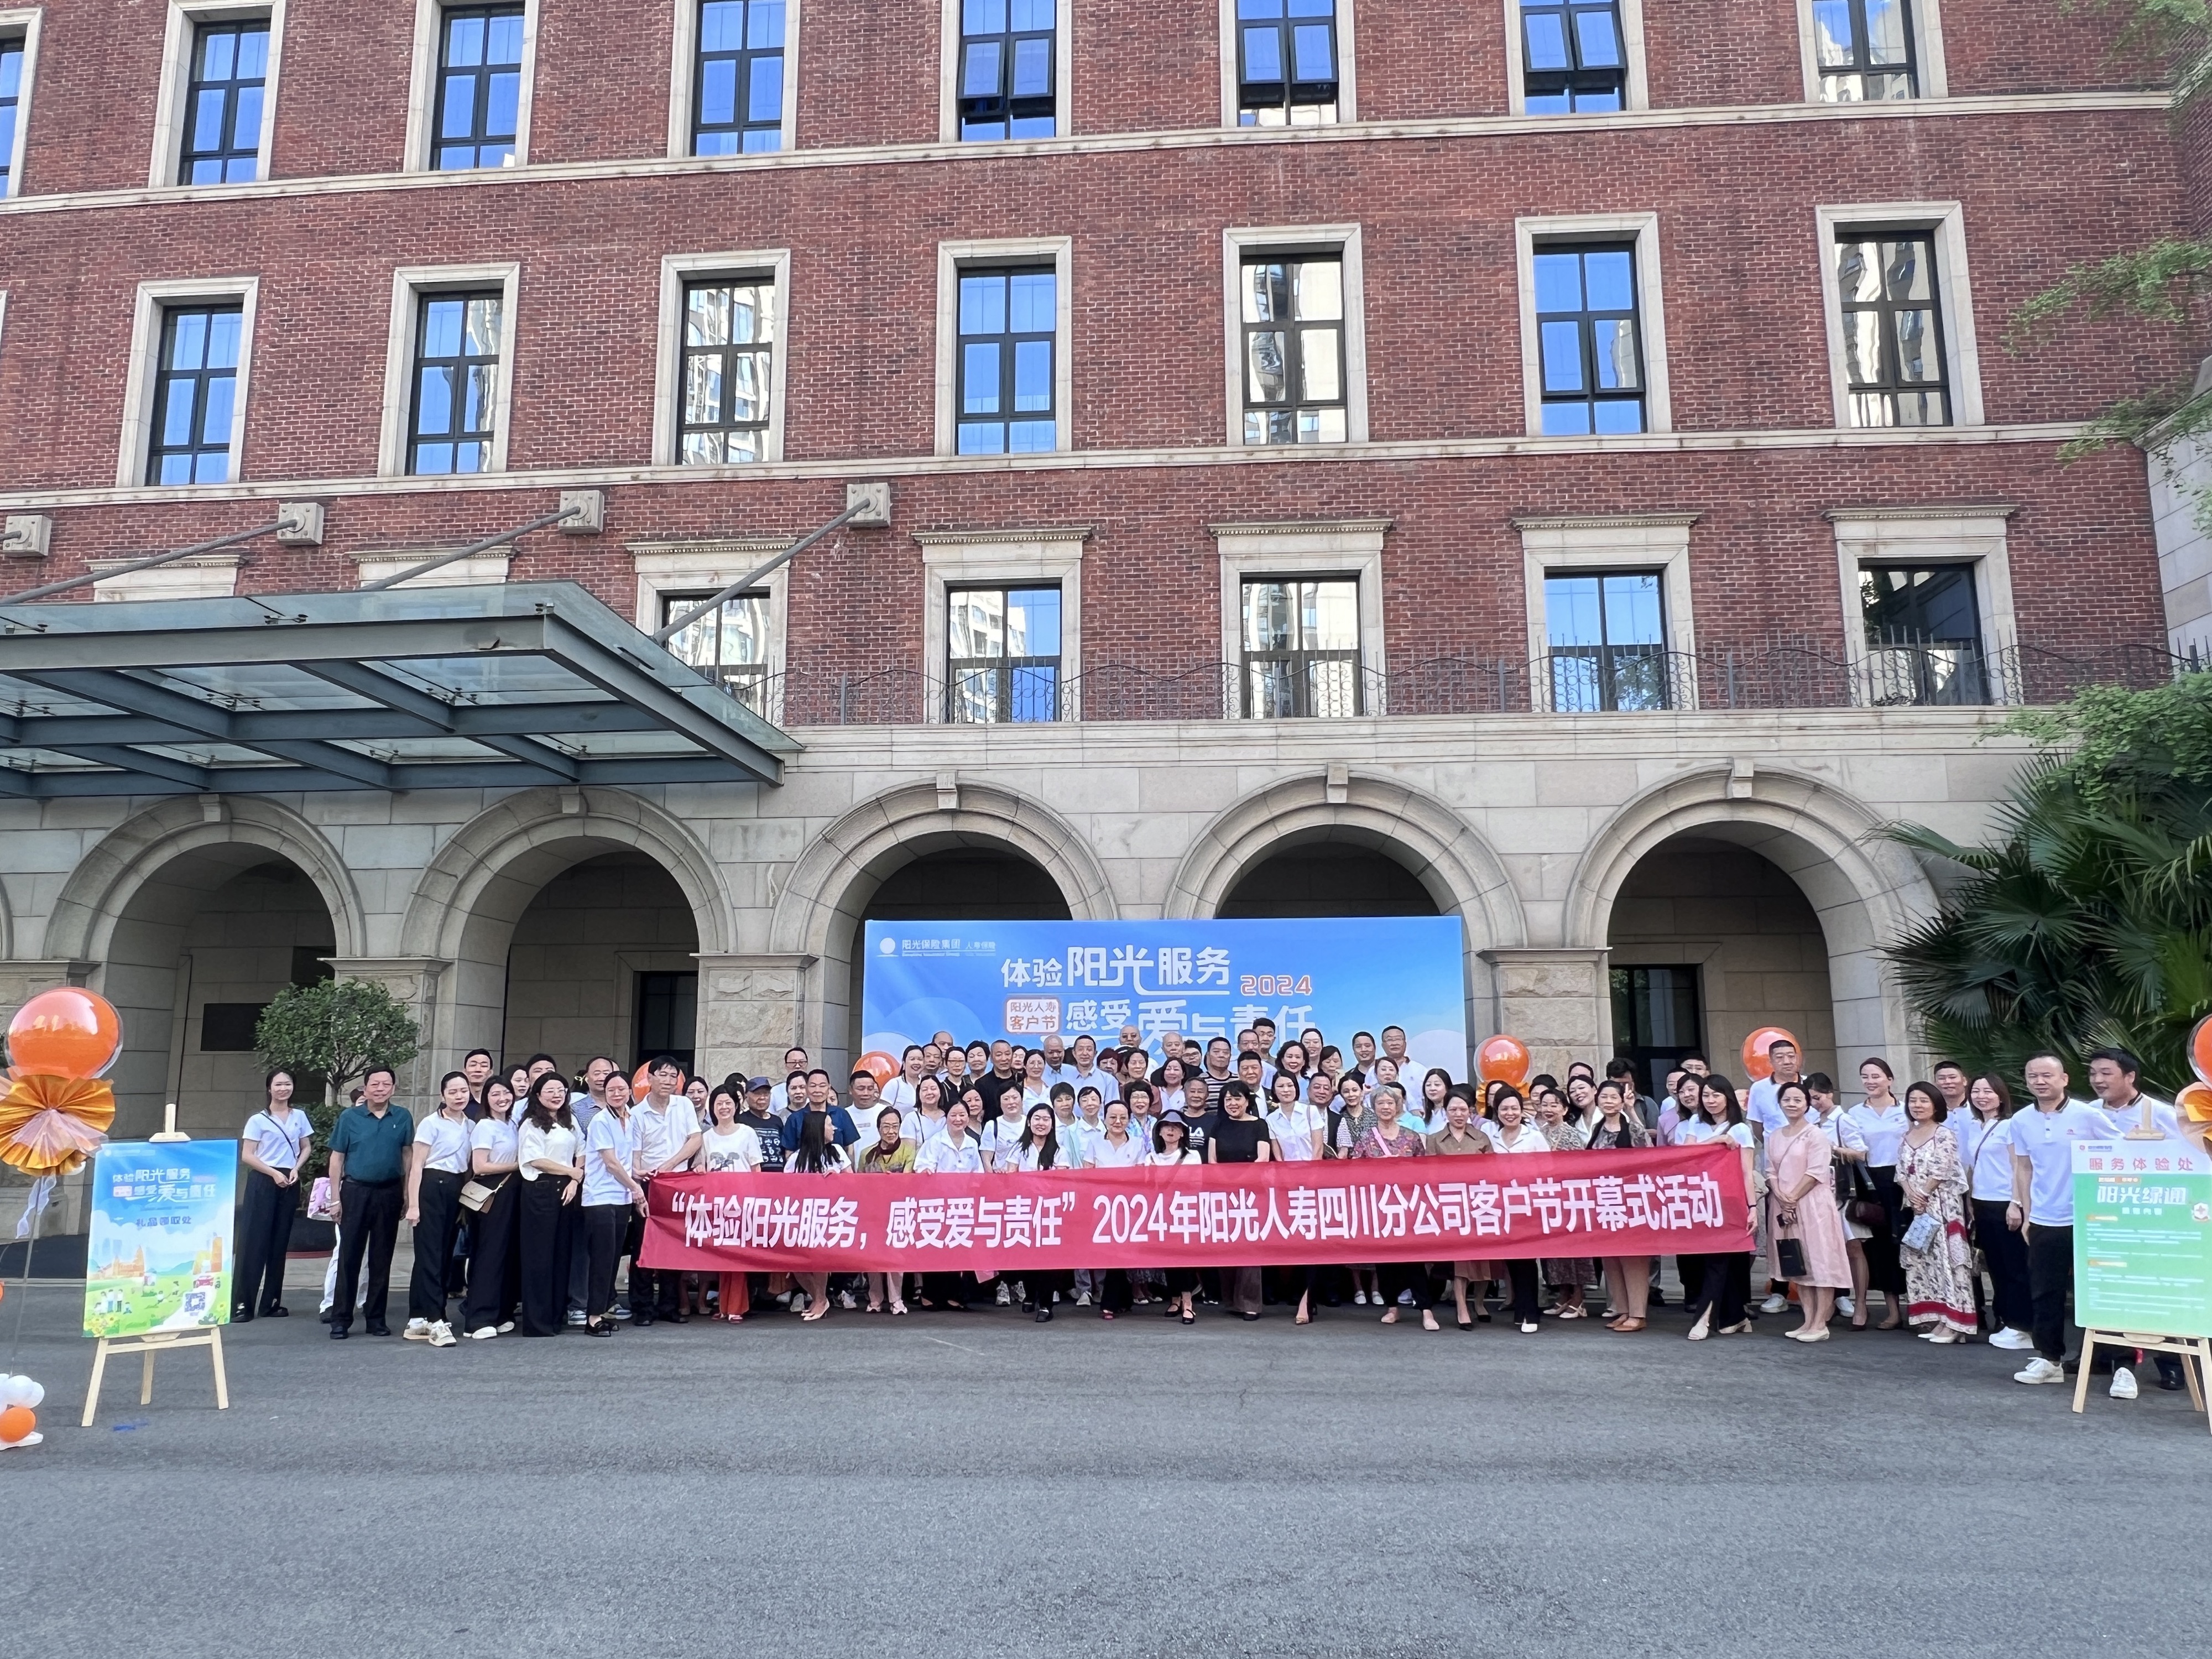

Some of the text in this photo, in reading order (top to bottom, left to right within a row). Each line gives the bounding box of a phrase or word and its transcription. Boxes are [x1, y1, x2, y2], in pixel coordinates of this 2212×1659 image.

[1000, 944, 1230, 995] 体验阳光服务
[1240, 974, 1312, 996] 2024
[1010, 1015, 1056, 1030] 客户节
[2089, 1157, 2194, 1171] 服务体验处
